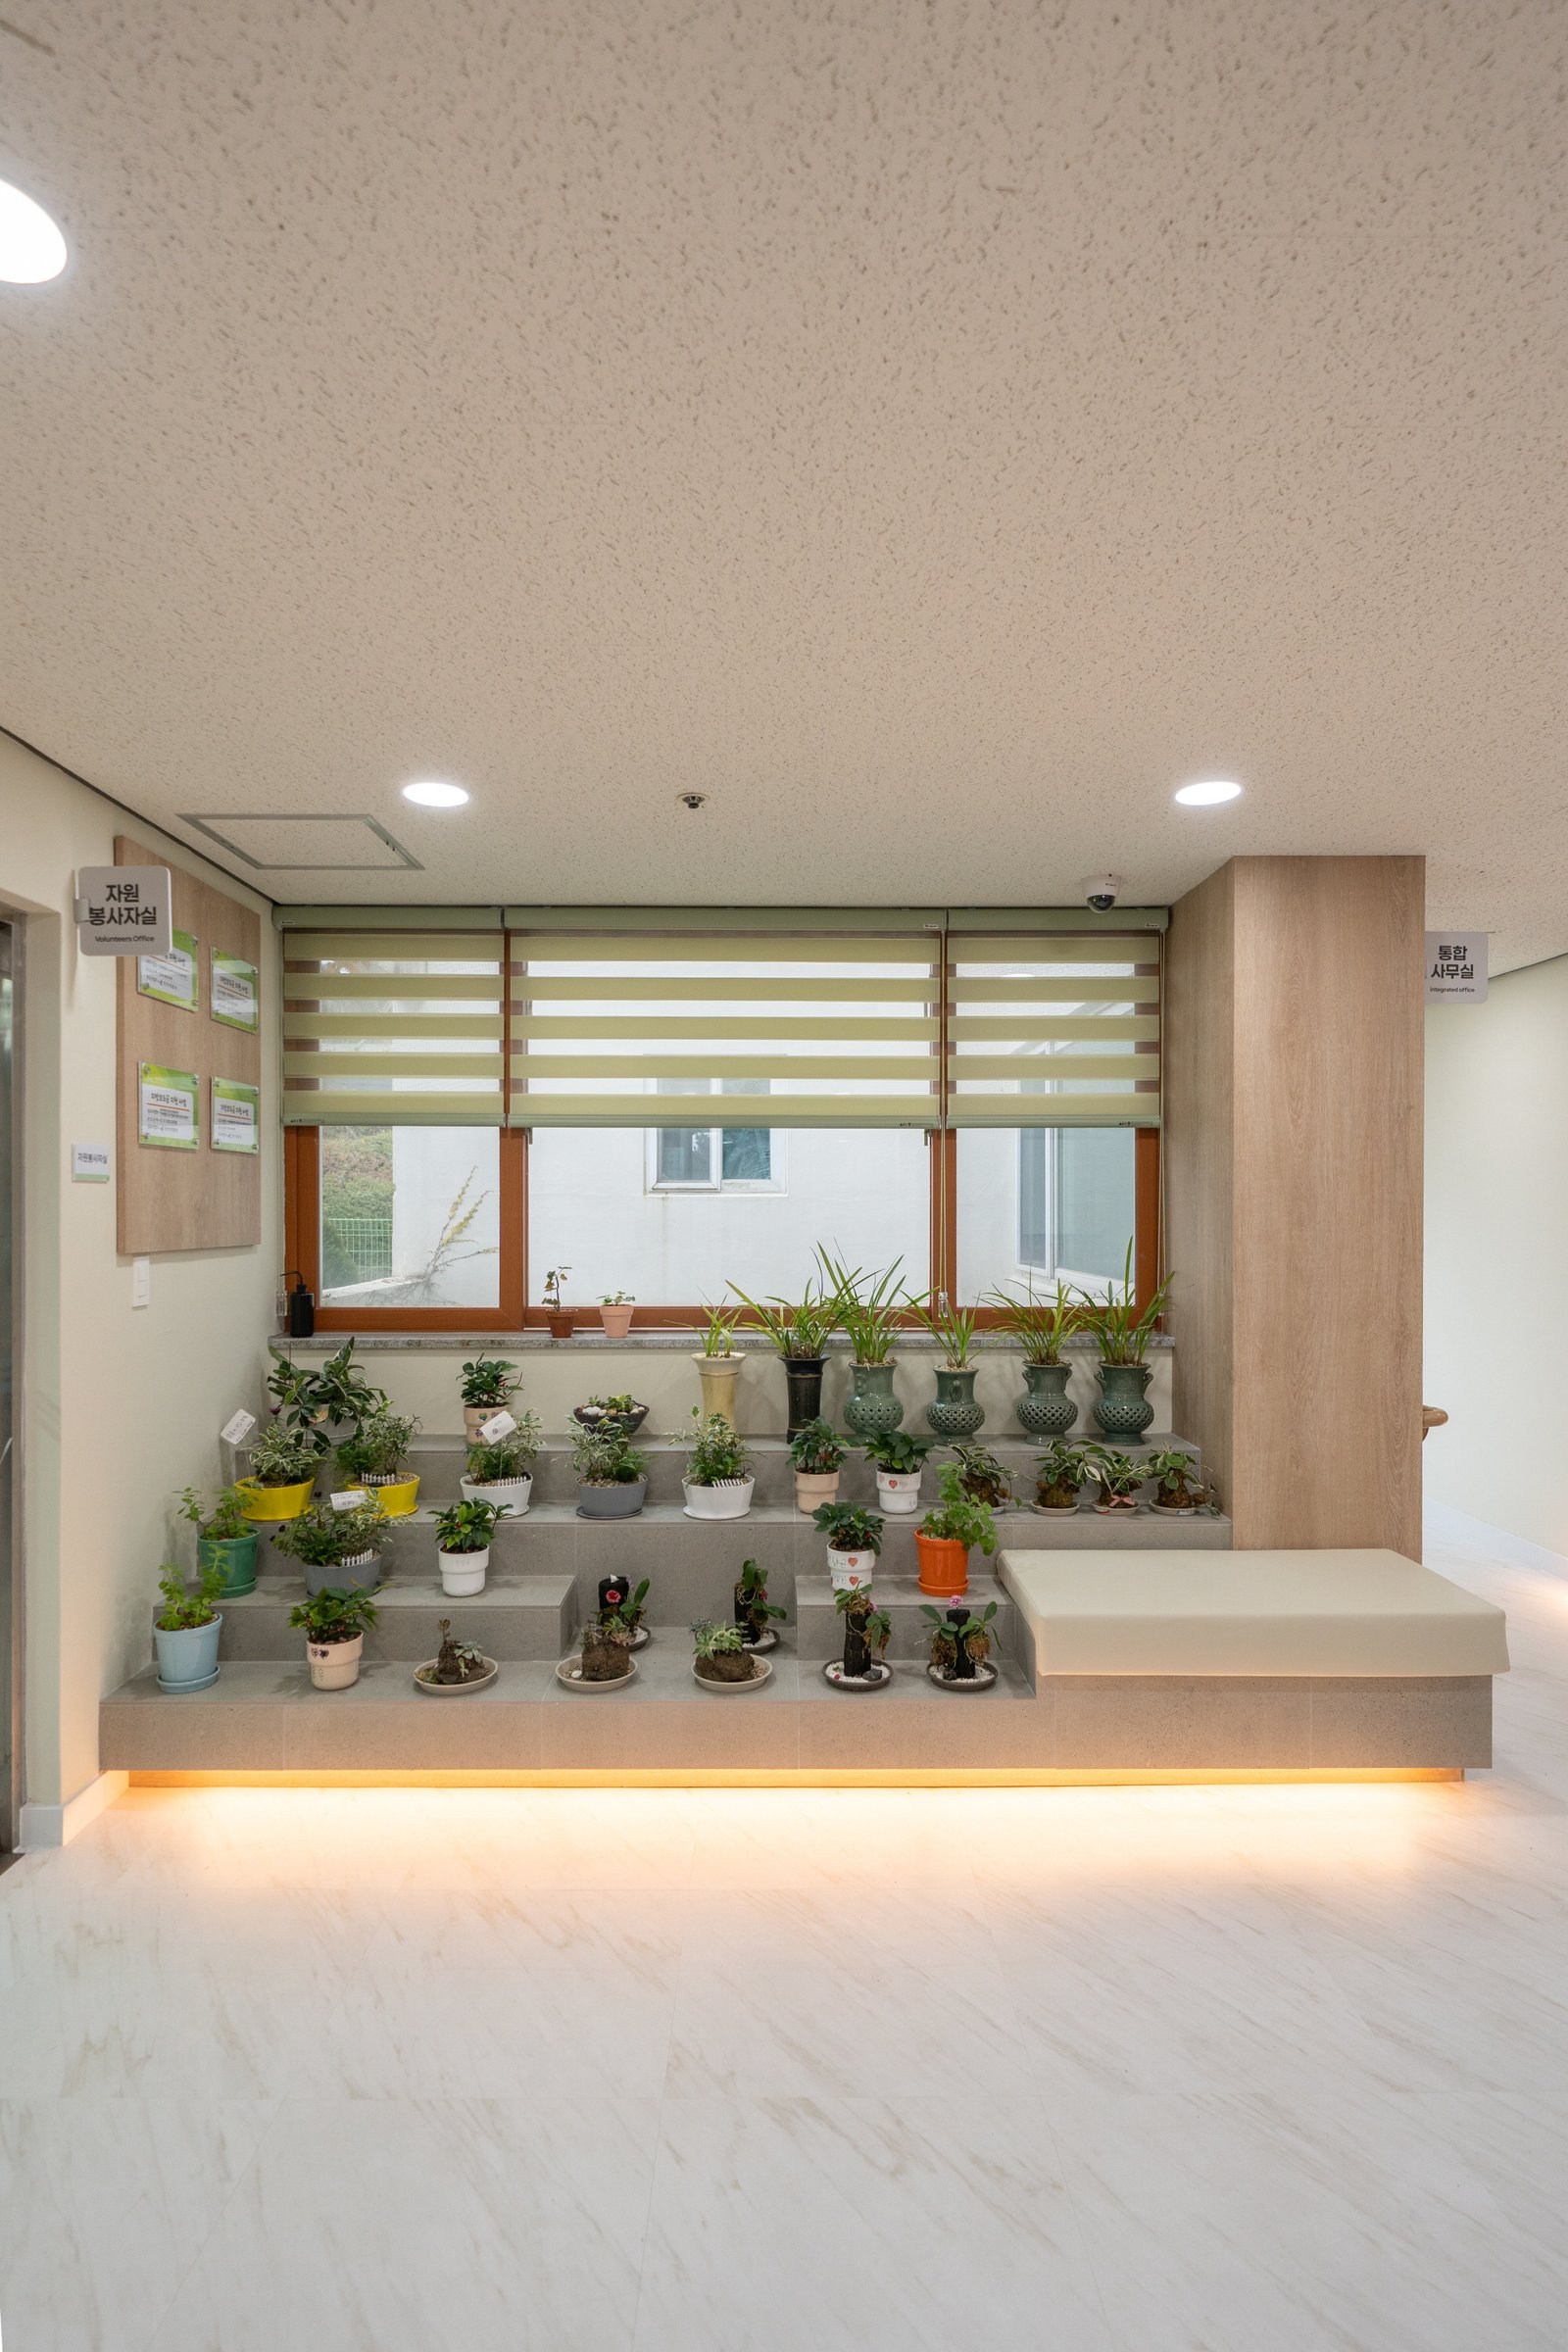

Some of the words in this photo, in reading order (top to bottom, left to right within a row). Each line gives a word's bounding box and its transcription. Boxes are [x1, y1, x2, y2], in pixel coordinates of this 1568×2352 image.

[106, 884, 139, 903] 자원
[89, 906, 157, 926] 봉사자실
[1438, 945, 1468, 961] 통합
[1431, 963, 1474, 979] 사무실
[77, 1152, 108, 1164] 자원봉사자실
